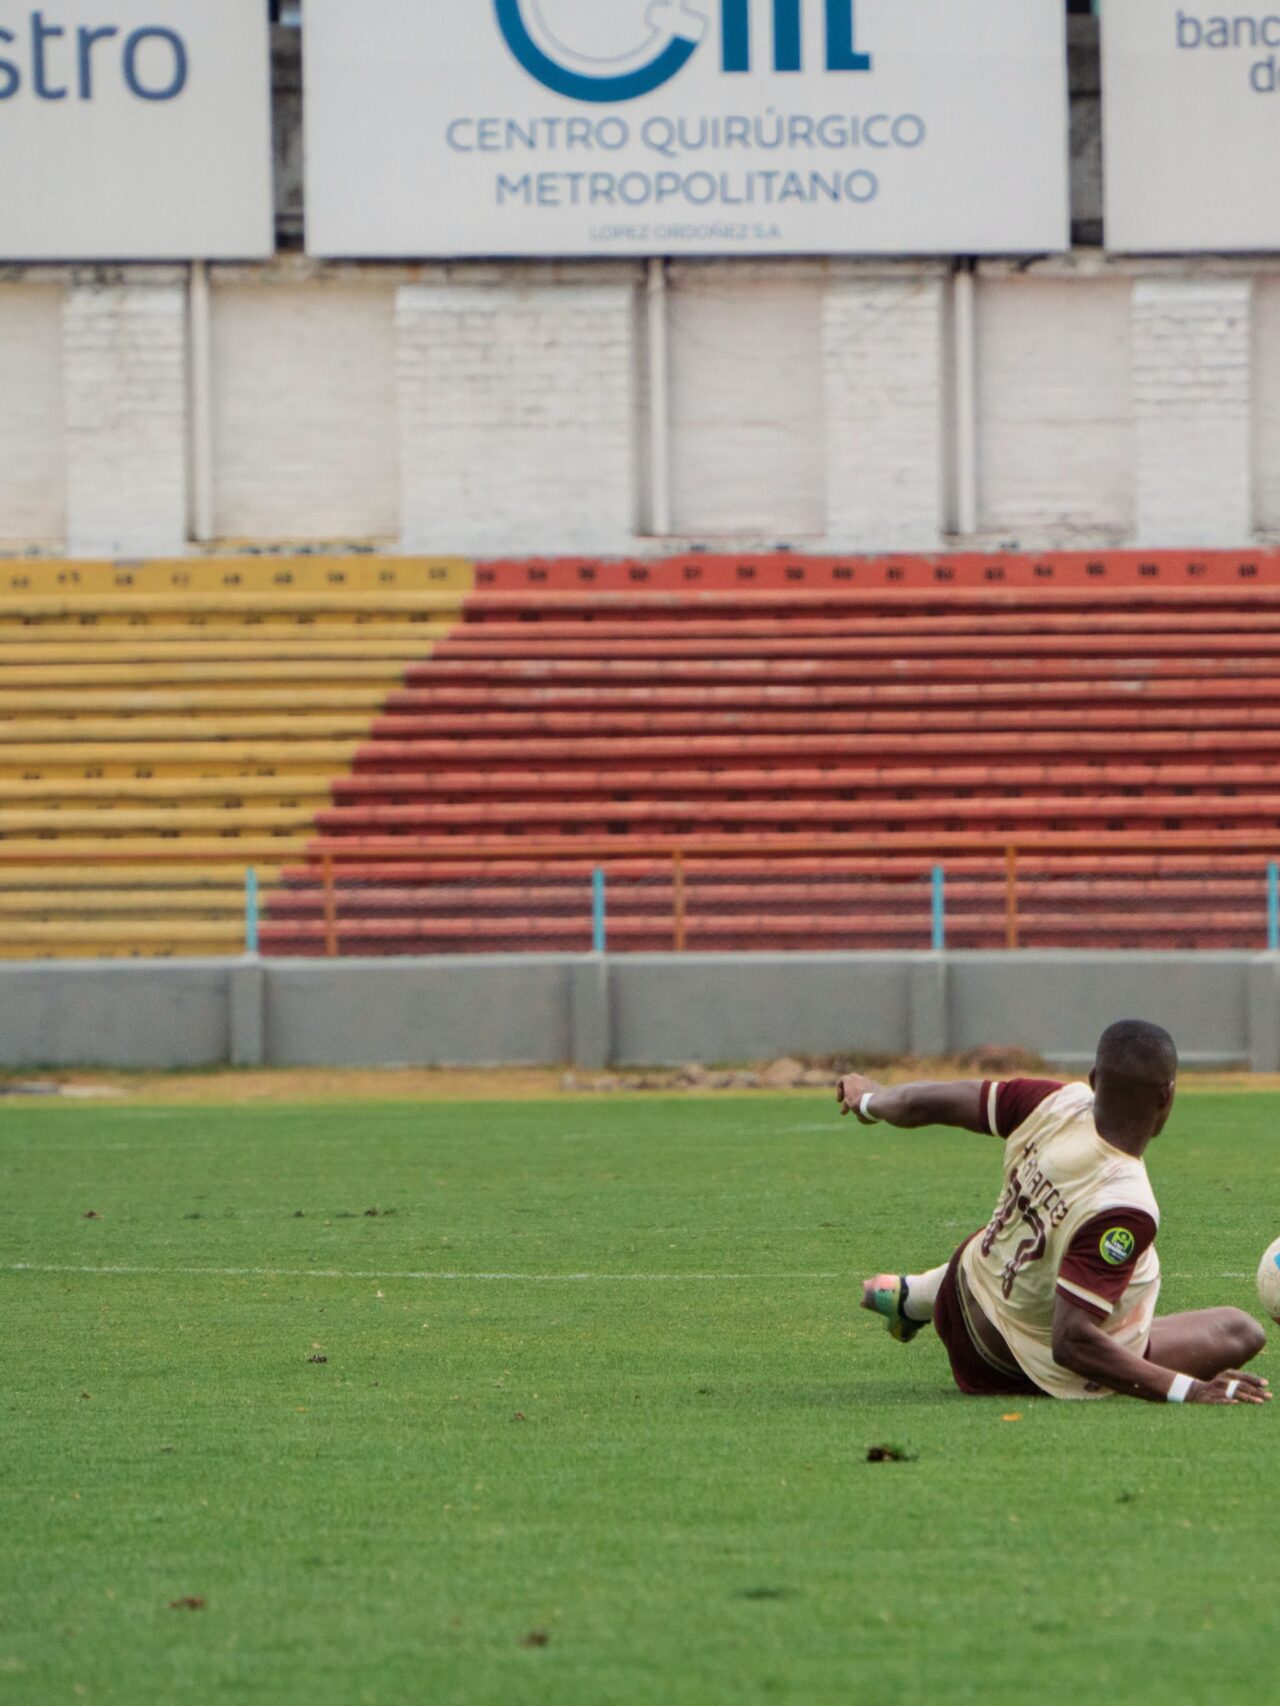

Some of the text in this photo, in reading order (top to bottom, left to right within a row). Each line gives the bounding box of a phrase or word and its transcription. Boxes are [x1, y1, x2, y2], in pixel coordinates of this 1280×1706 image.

[445, 107, 926, 156] CENTRO QUIRÚRGICO
[496, 169, 878, 206] METROPOLITANO
